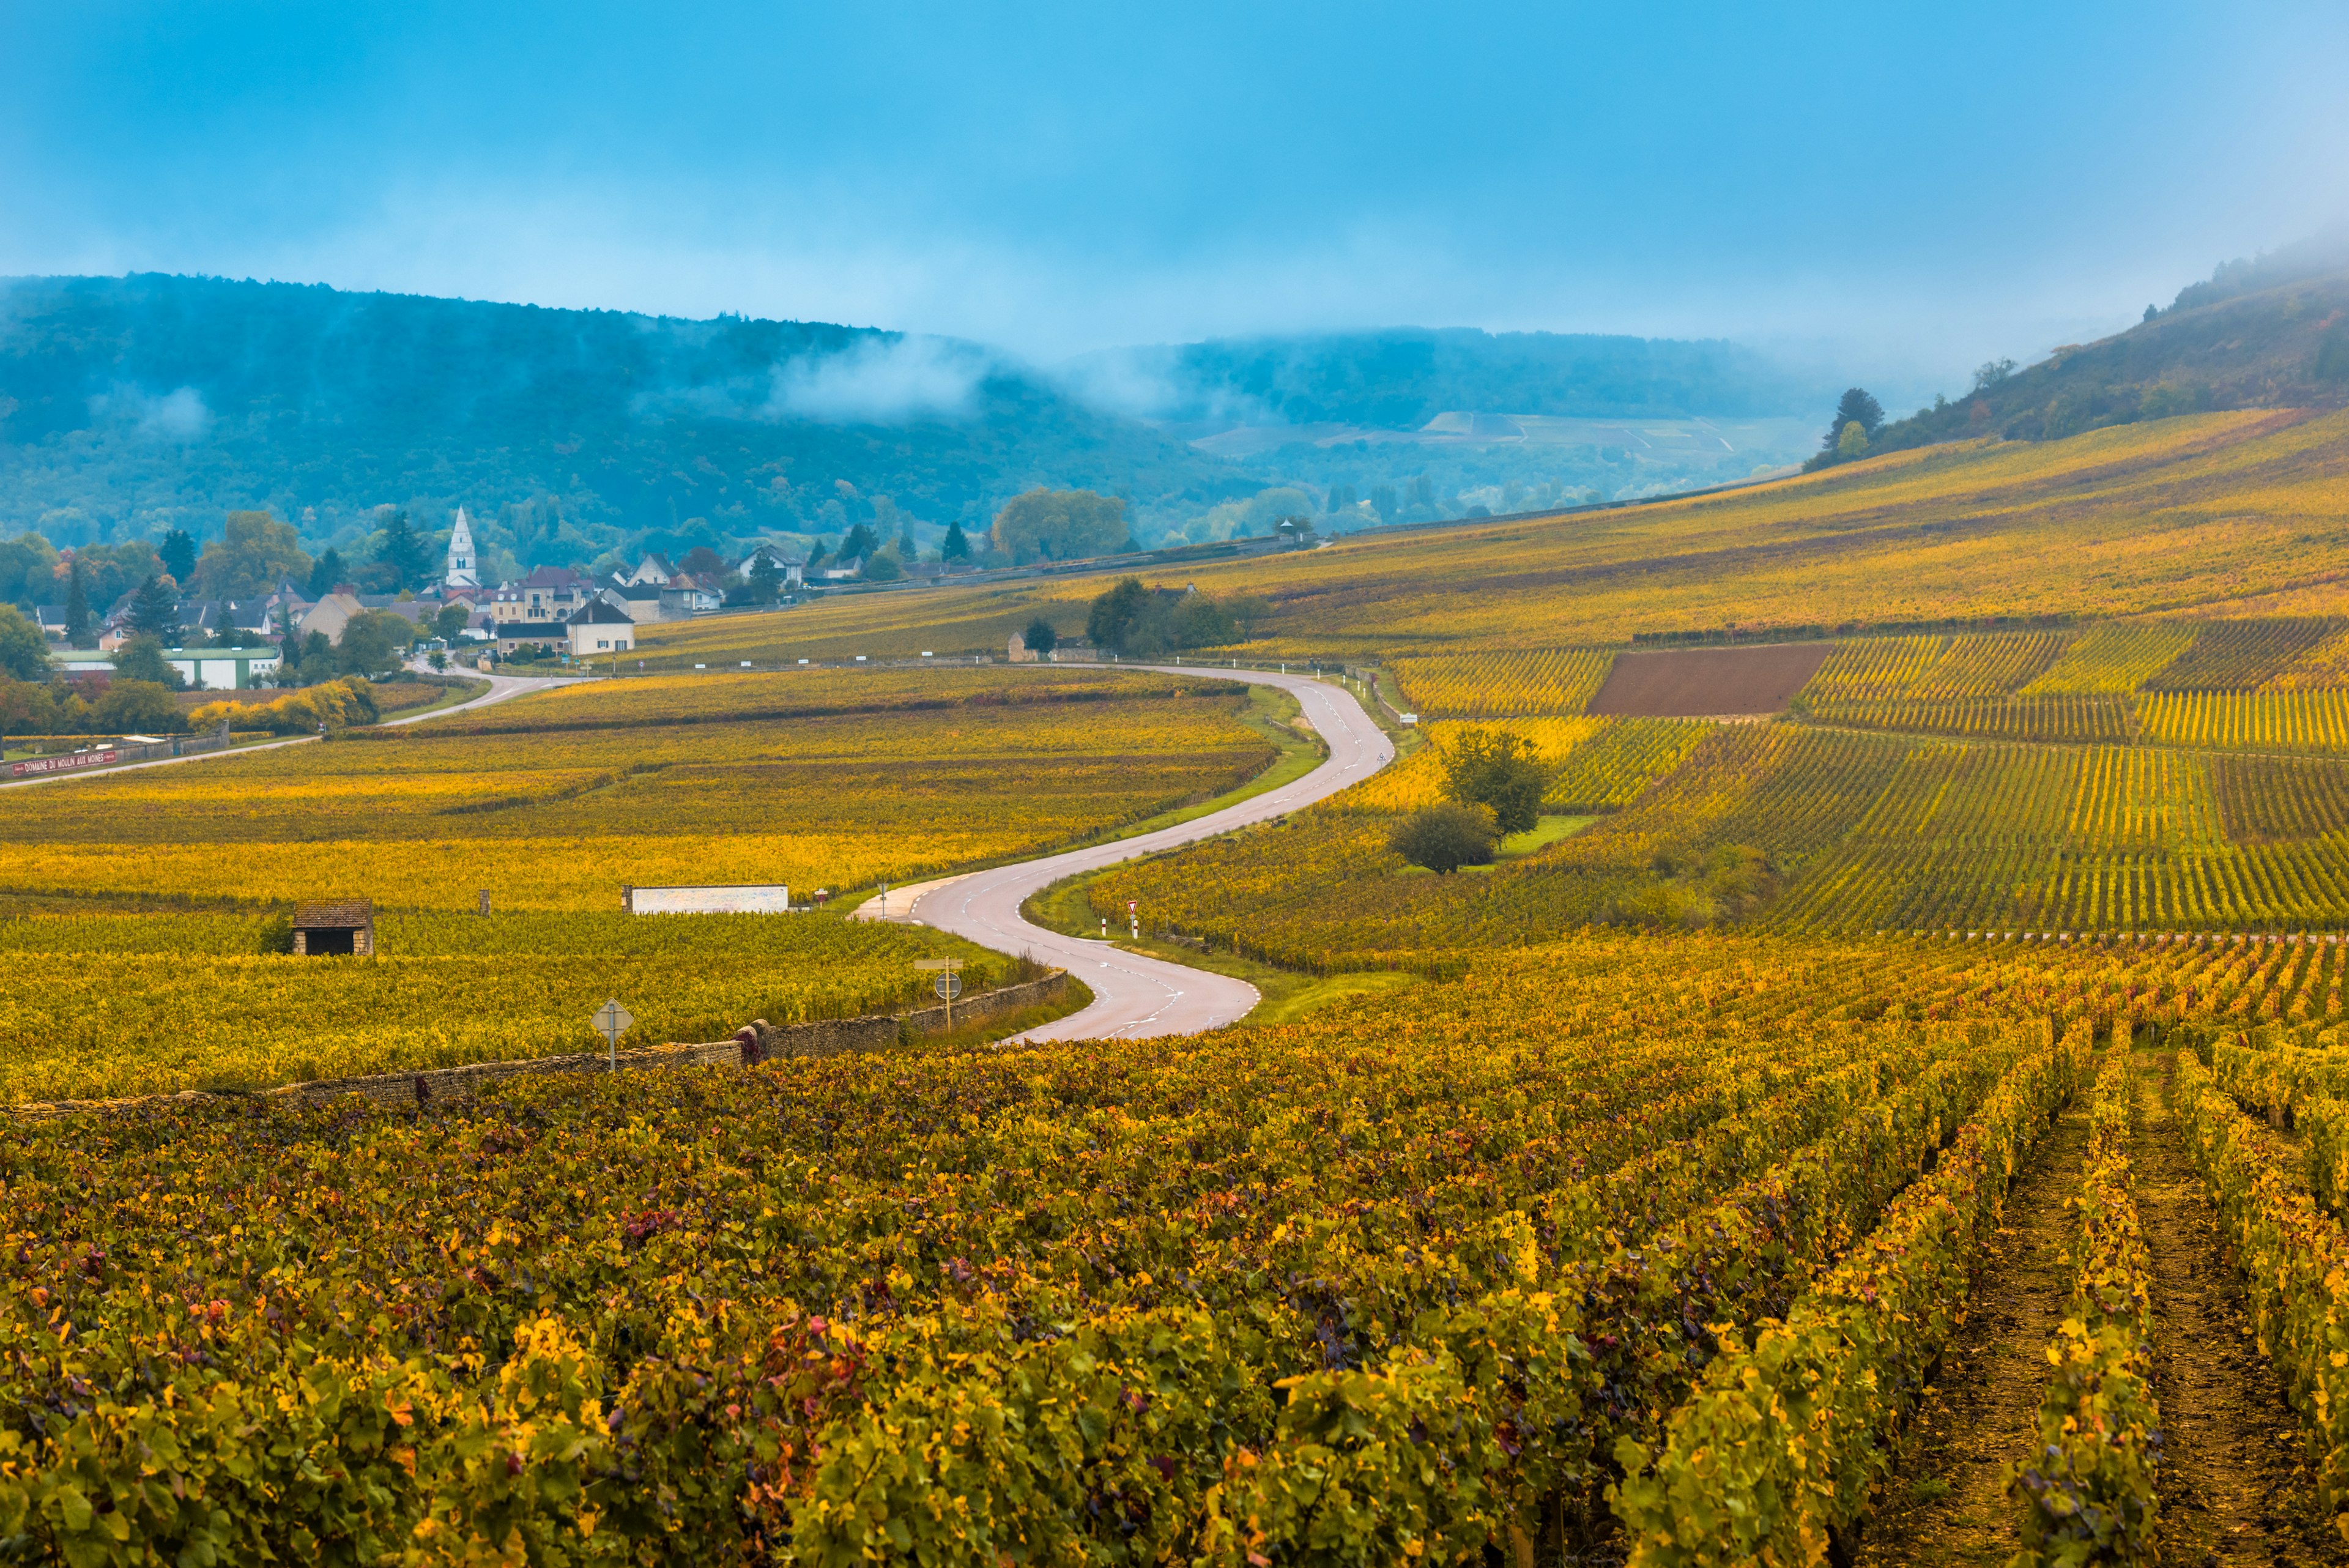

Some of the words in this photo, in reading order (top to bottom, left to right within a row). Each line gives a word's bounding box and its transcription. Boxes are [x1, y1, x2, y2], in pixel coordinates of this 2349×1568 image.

[24, 762, 47, 772] DOMAINE
[49, 760, 56, 769] DU
[58, 757, 75, 768] MOULIN
[77, 756, 86, 765] AUX
[87, 754, 104, 764] MOINES
